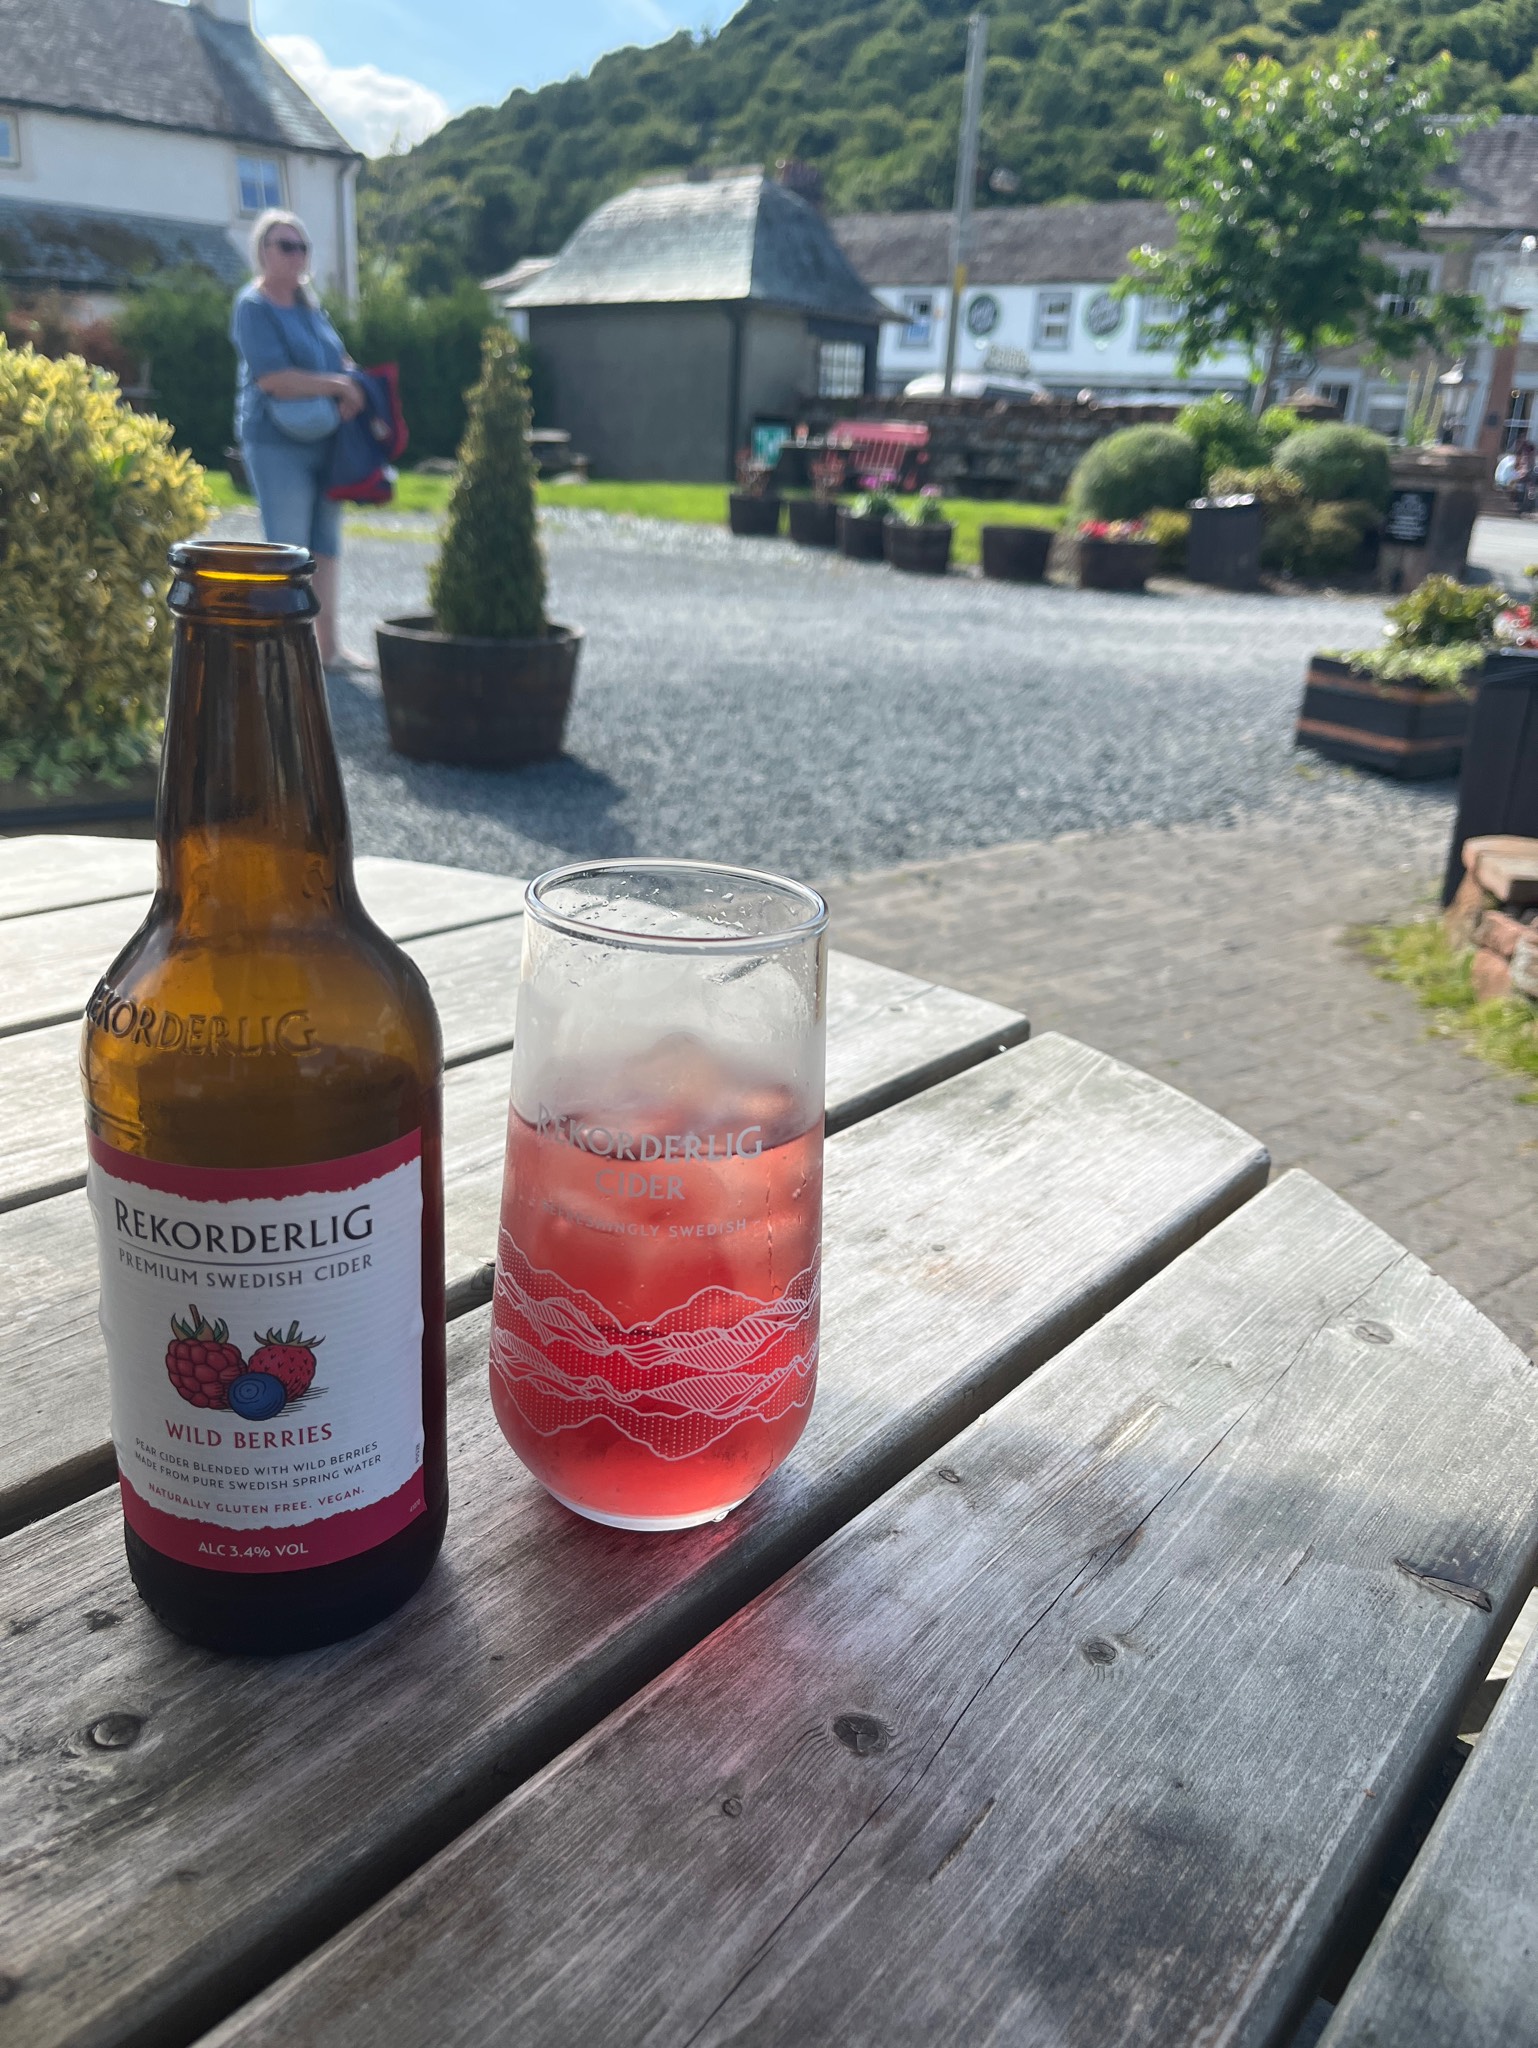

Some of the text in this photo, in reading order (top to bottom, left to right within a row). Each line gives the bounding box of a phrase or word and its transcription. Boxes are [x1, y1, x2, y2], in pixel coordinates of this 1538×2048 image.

[536, 1102, 763, 1163] REKORDERLIG
[595, 1168, 686, 1200] CIDER
[114, 1197, 374, 1255] REKORDERLIG
[669, 1219, 746, 1238] SWEDISH
[119, 1248, 373, 1289] PREMIUM SWEDISH CIDER
[165, 1419, 332, 1449] WILD BERRIES
[135, 1437, 378, 1476] PEAR CIDER BLENDED WITH WILD BERRIES
[135, 1451, 382, 1491] MADE FROM PURE SWEDISH SPRING WATER
[148, 1482, 365, 1514] NATURALLY GLUTEN FREE. VEGAN.
[198, 1541, 309, 1558] ALC 3.4% VOL
